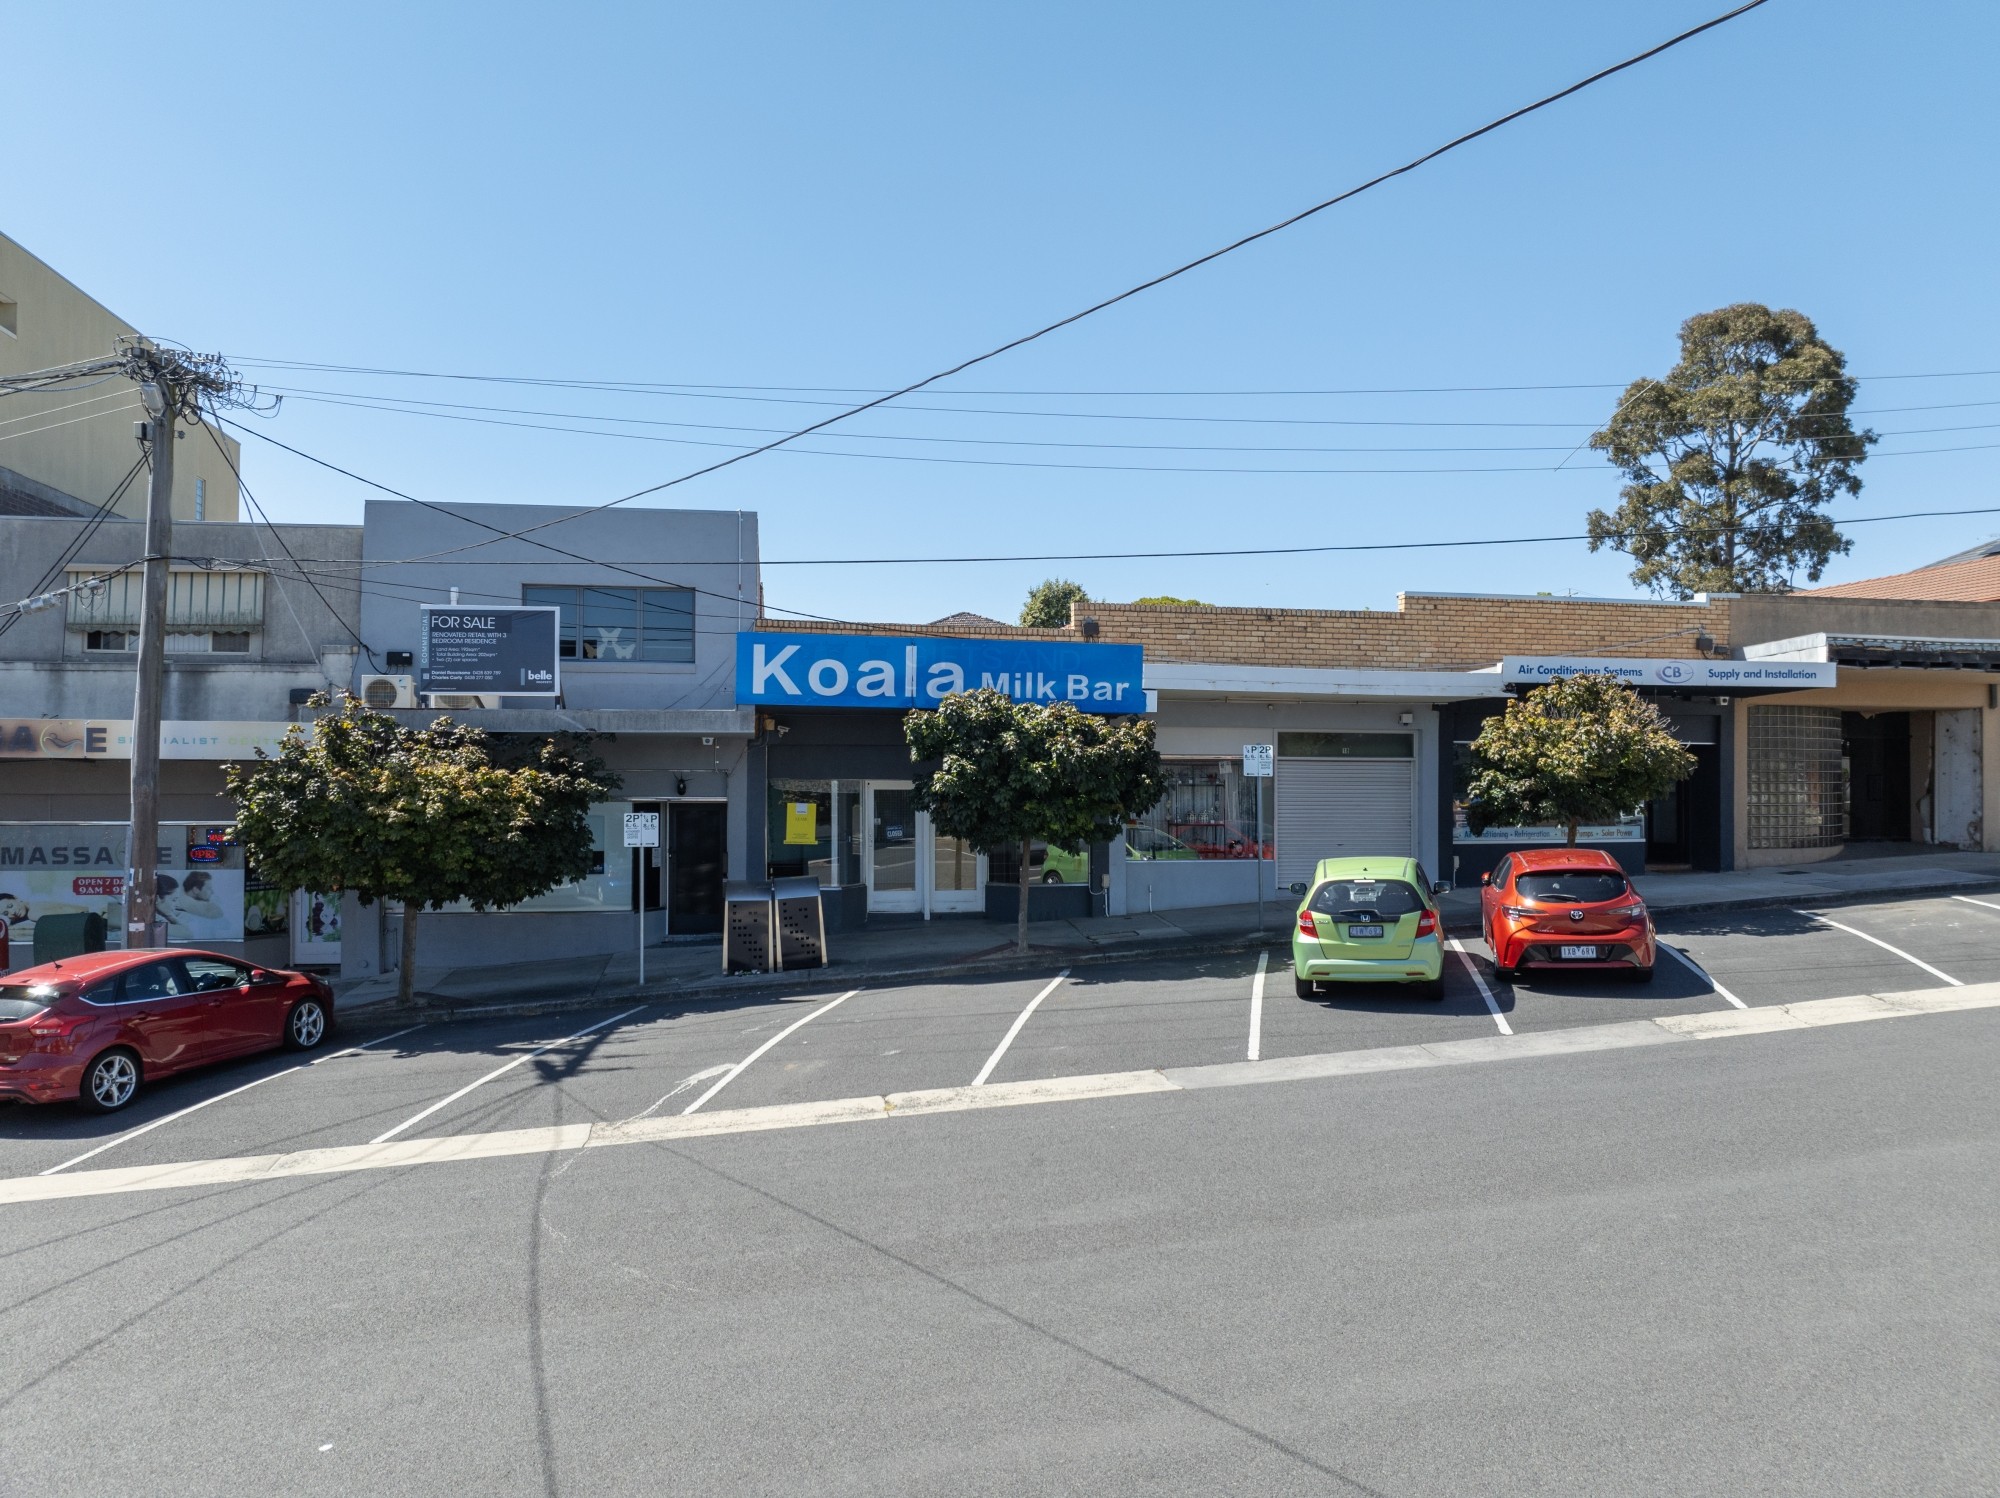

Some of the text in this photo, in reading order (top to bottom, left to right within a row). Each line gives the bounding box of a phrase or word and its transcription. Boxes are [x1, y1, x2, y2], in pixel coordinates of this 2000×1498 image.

[431, 616, 496, 629] FOR SALE
[528, 670, 553, 680] belle
[751, 643, 1130, 702] Koala Milk Bar
[1518, 664, 1817, 681] Air Conditioning Systems CB Supply and Installation
[117, 736, 218, 745] SIALIST
[1259, 746, 1271, 754] 2P
[625, 814, 640, 822] 2P
[1514, 830, 1550, 839] Refrigeration
[1601, 829, 1615, 837] Solar
[1616, 829, 1633, 837] Power
[0, 846, 172, 866] MASSAE
[78, 878, 103, 886] OPEN
[1581, 947, 1595, 956] 6RV
